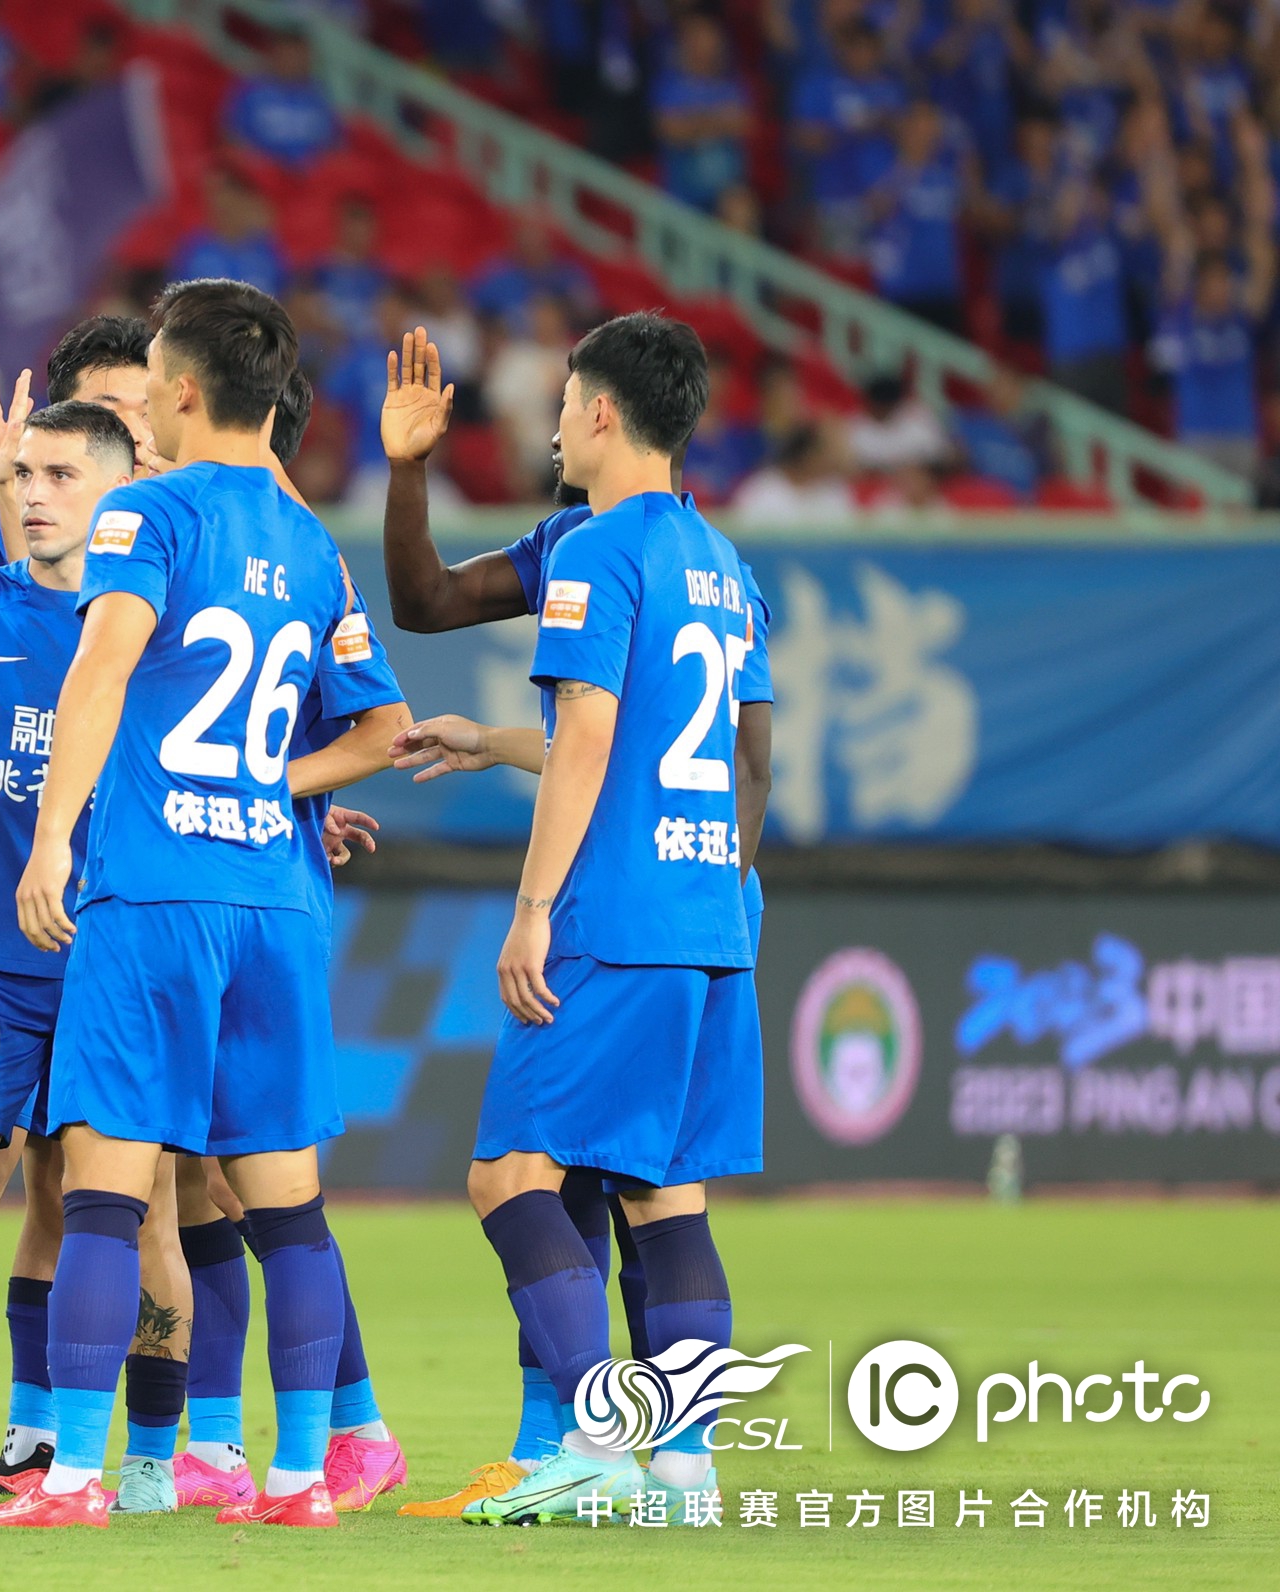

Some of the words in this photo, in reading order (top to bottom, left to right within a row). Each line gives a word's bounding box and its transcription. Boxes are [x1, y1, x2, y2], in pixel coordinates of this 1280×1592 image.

[244, 556, 269, 596] HE
[273, 564, 290, 602] G.
[685, 568, 719, 607] DENG
[159, 606, 312, 785] 26
